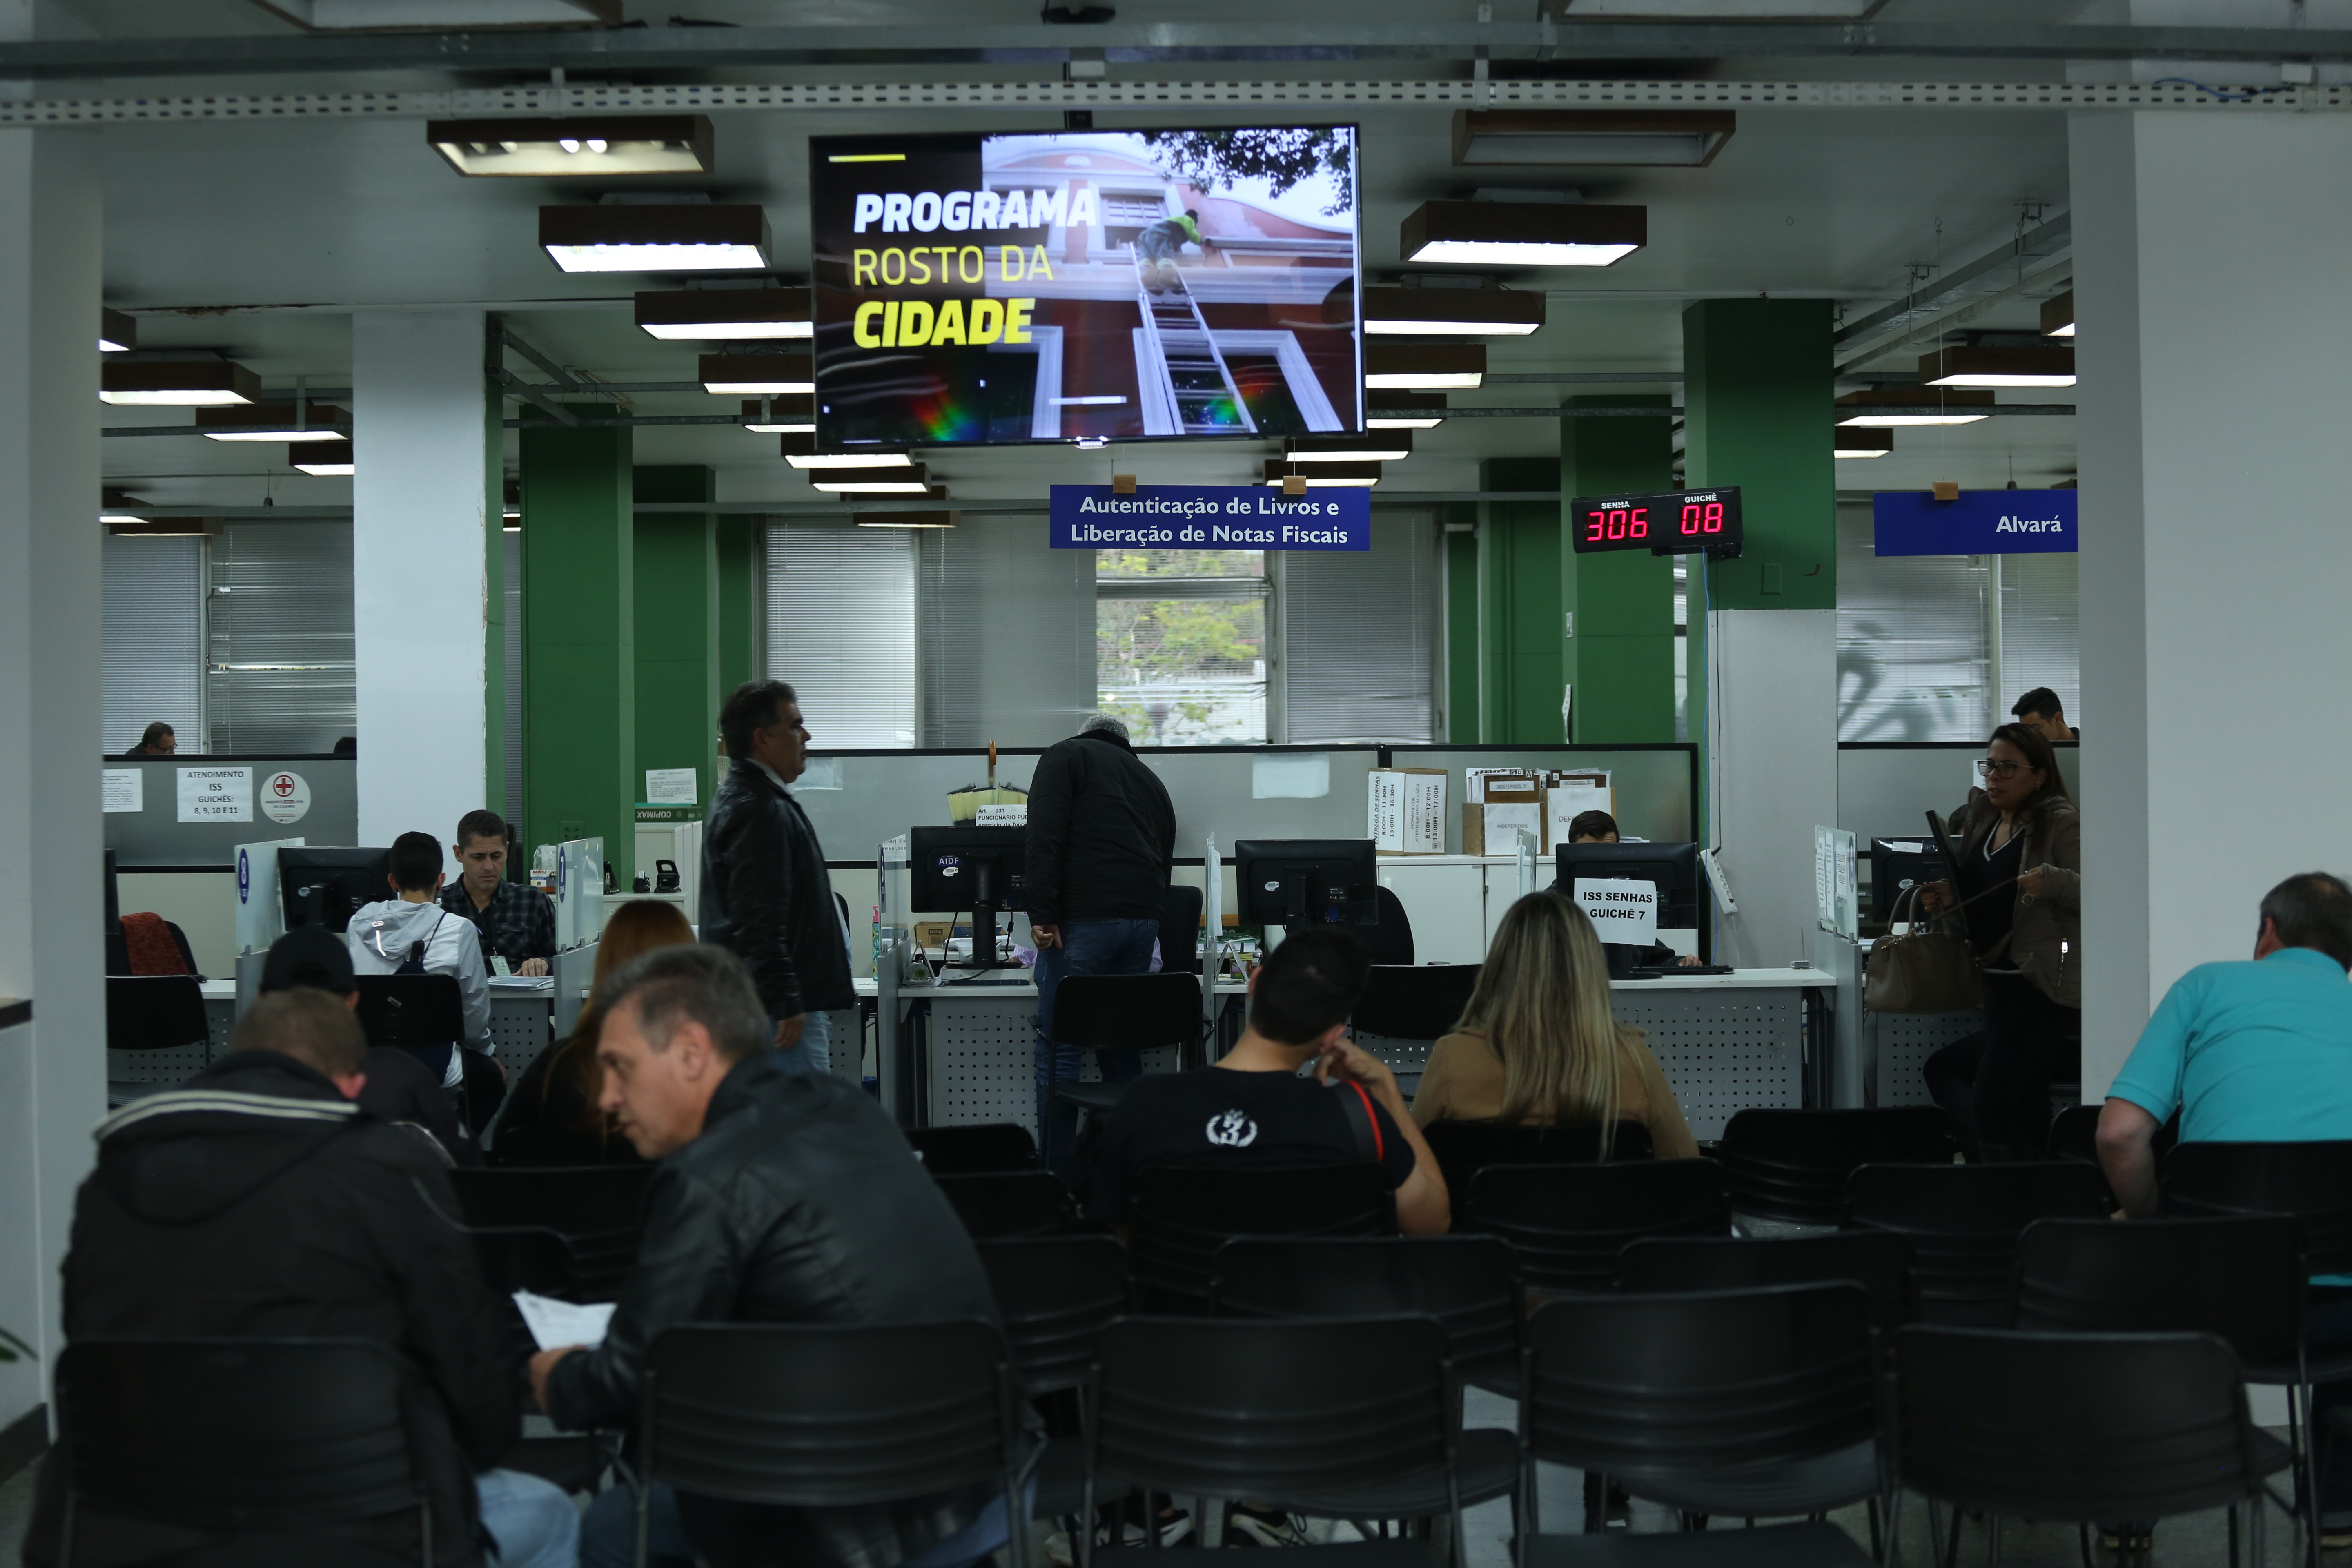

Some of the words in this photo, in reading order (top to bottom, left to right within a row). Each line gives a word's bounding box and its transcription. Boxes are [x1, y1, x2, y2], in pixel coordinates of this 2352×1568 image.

[854, 189, 1096, 233] PROGRAMA
[854, 246, 984, 286] ROSTO
[1000, 245, 1054, 282] DA
[853, 298, 1036, 349] CIDADE
[1080, 496, 1219, 519] Autenticação
[1226, 497, 1251, 515] de
[1259, 497, 1320, 515] Livros
[1327, 503, 1339, 516] e
[1601, 501, 1630, 510] SENHA
[1684, 493, 1717, 503] GUICHÊ
[1587, 508, 1648, 541] 306
[1681, 503, 1723, 535] 08
[1996, 515, 2062, 532] Alvará
[1071, 524, 1173, 547] Liberação
[1180, 525, 1205, 543] de
[1212, 525, 1275, 544] Notas
[1282, 526, 1348, 544] Fiscais
[198, 794, 234, 802] GUICHÊS:
[1374, 803, 1379, 812] DE
[241, 857, 247, 884] 8
[1584, 892, 1602, 901] ISS
[1605, 892, 1652, 903] SENHAS
[1590, 909, 1635, 919] GUICHÊ
[1639, 911, 1646, 920] 7
